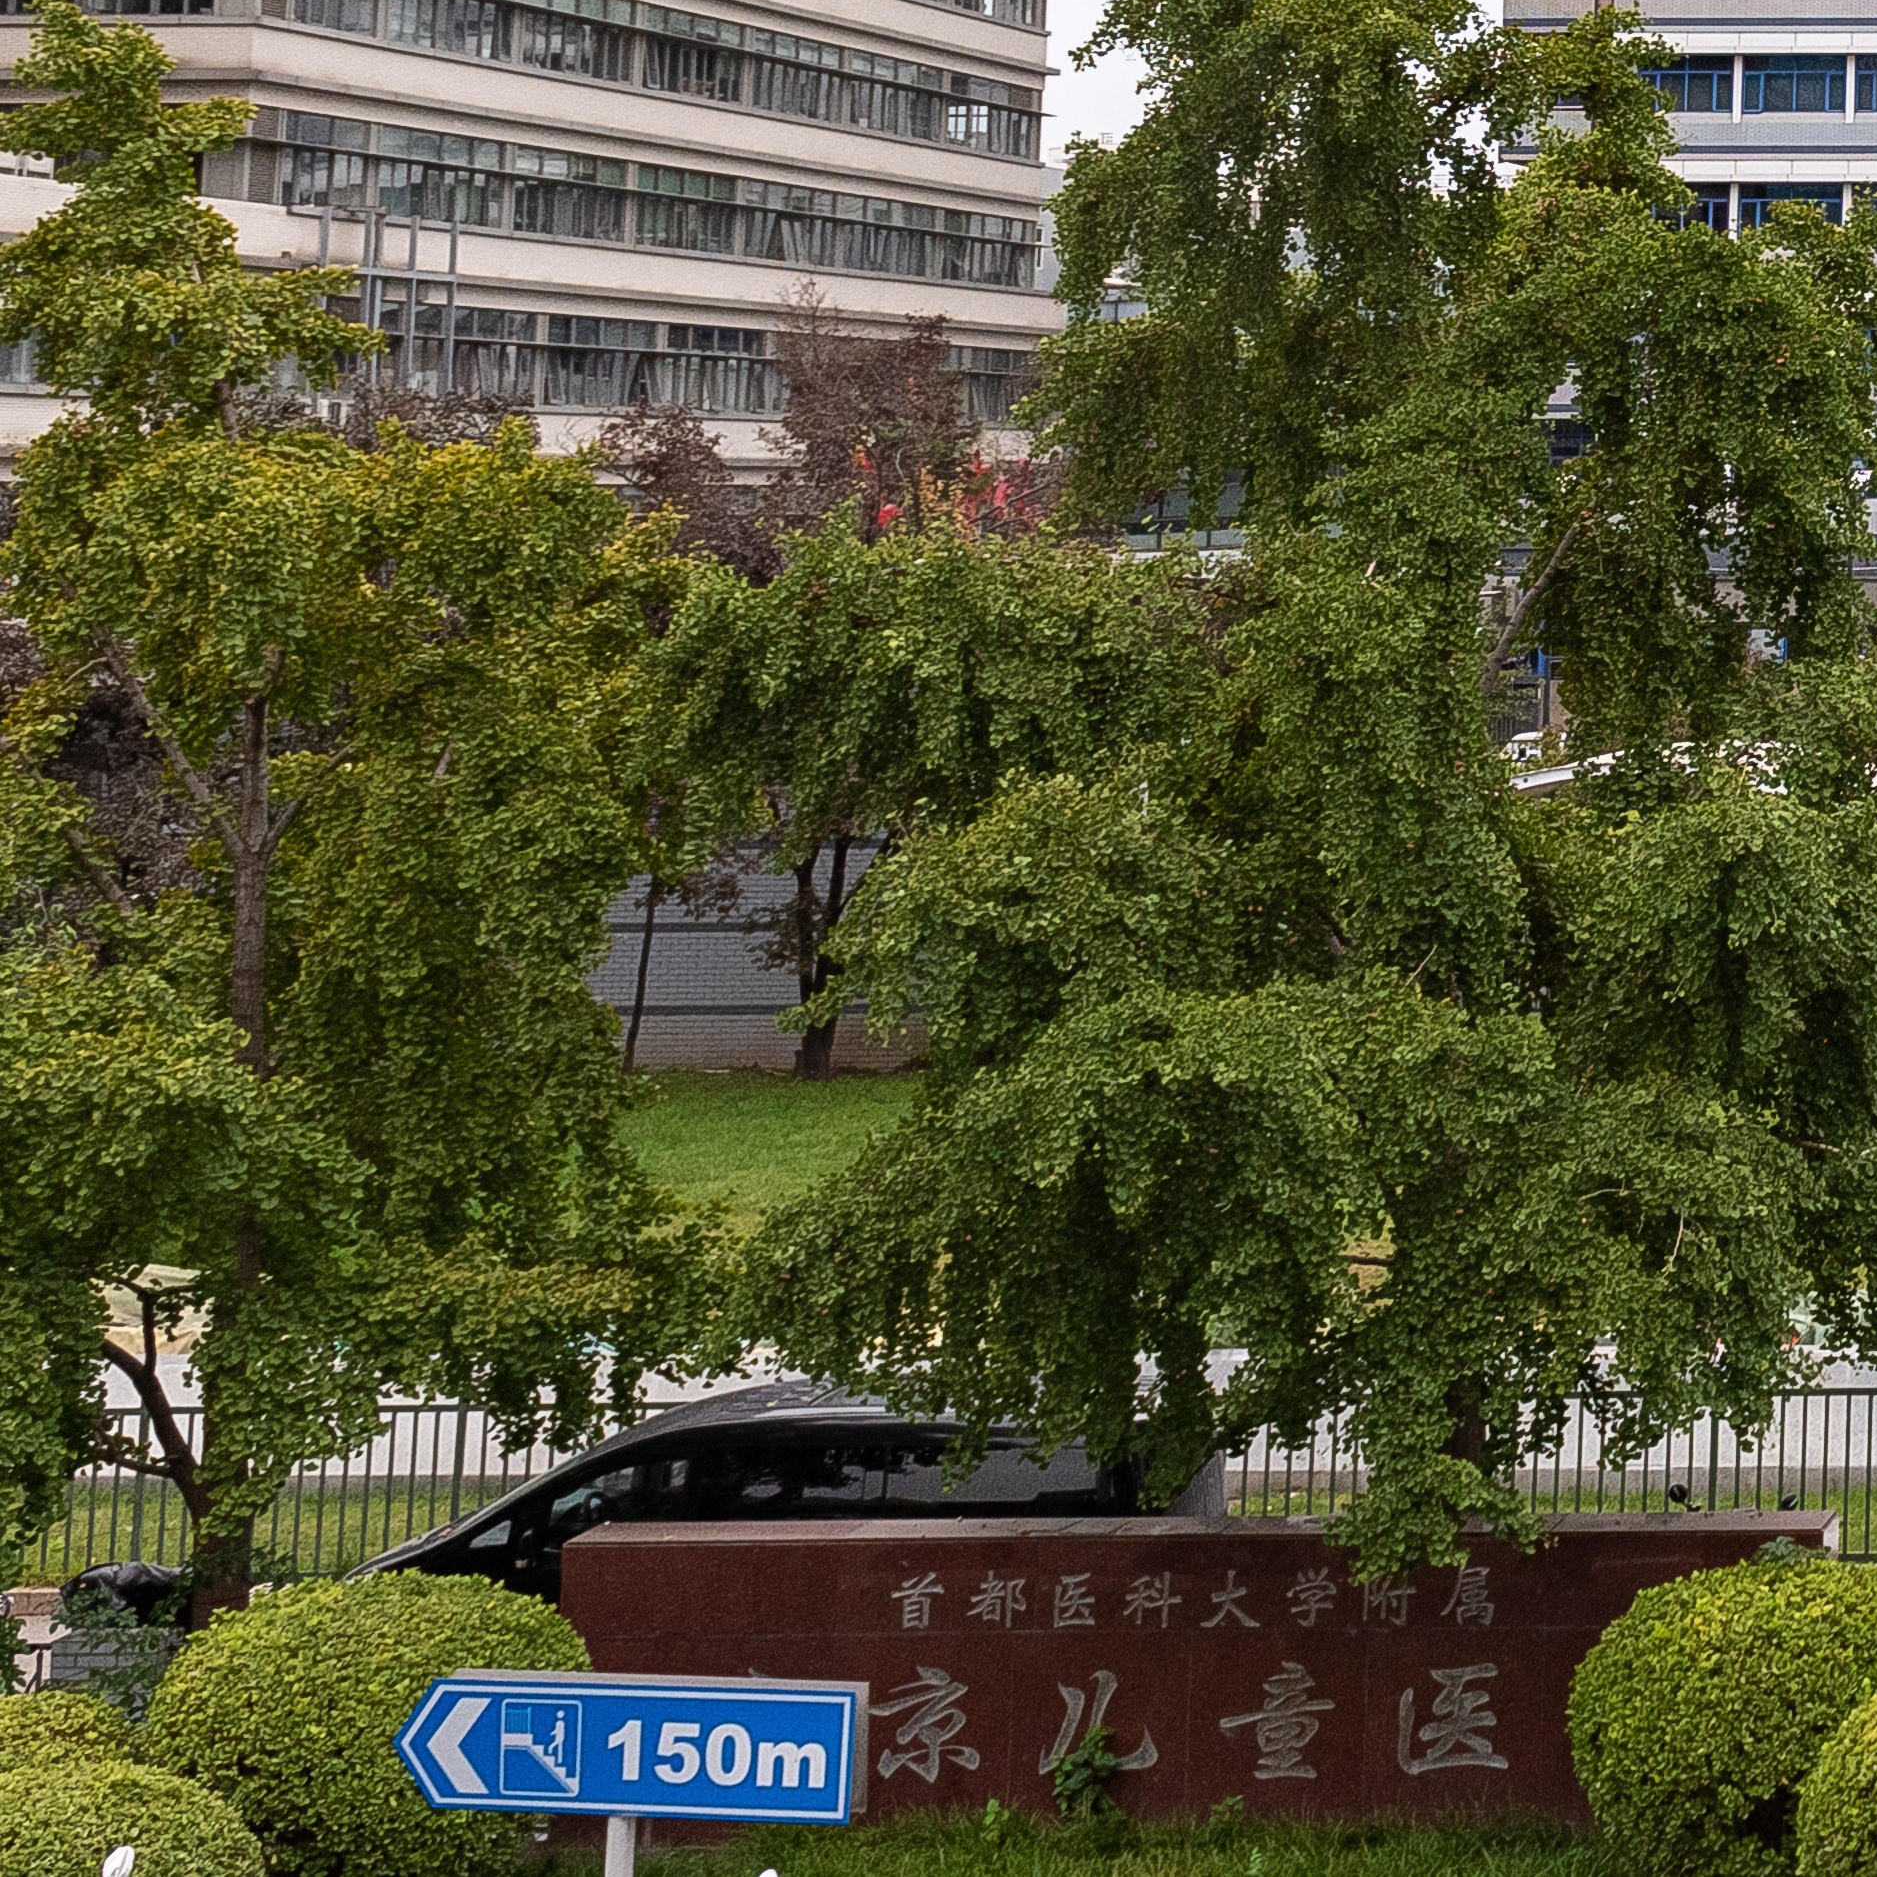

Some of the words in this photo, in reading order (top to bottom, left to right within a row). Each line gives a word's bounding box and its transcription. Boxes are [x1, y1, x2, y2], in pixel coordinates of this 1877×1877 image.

[891, 1566, 1497, 1628] 首都医科大学附属
[608, 1718, 829, 1790] 150m
